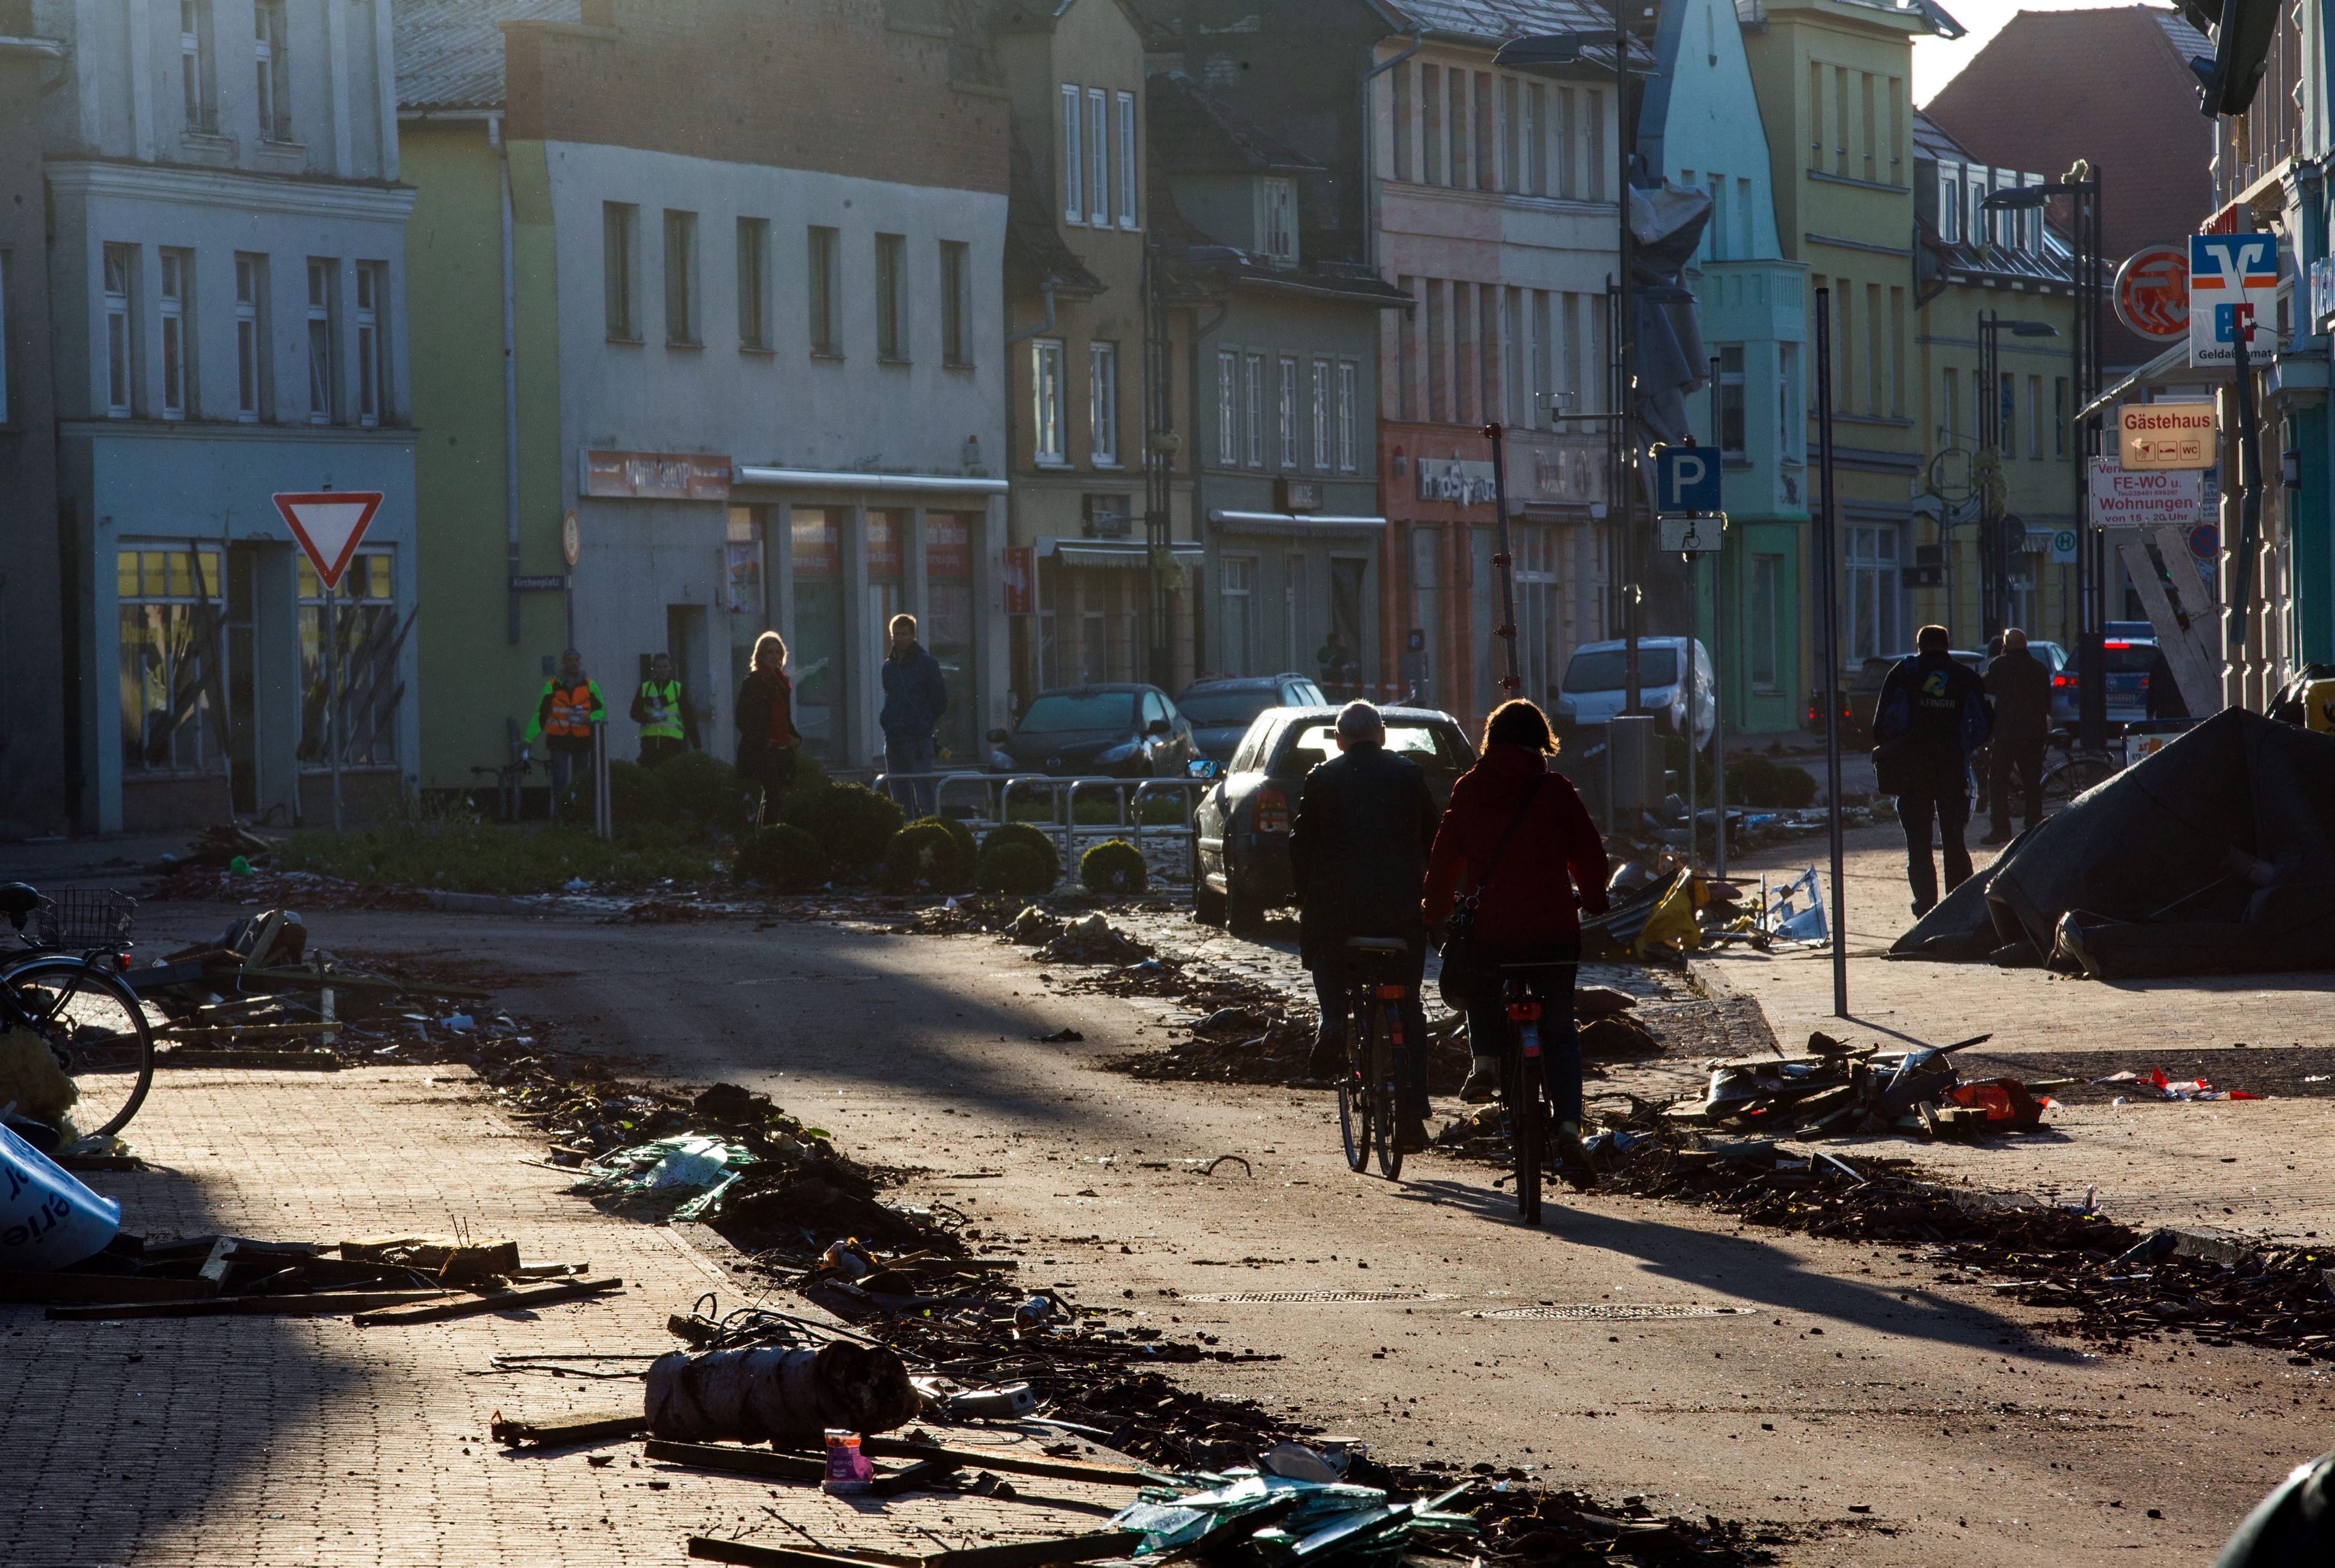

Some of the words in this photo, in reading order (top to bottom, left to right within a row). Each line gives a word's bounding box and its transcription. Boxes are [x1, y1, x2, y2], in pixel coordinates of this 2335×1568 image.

[2125, 413, 2211, 430] Gästehaus
[1673, 455, 1706, 504] P
[2113, 475, 2167, 490] FE-WO
[2100, 497, 2193, 511] Wohnungen
[2060, 536, 2071, 548] H
